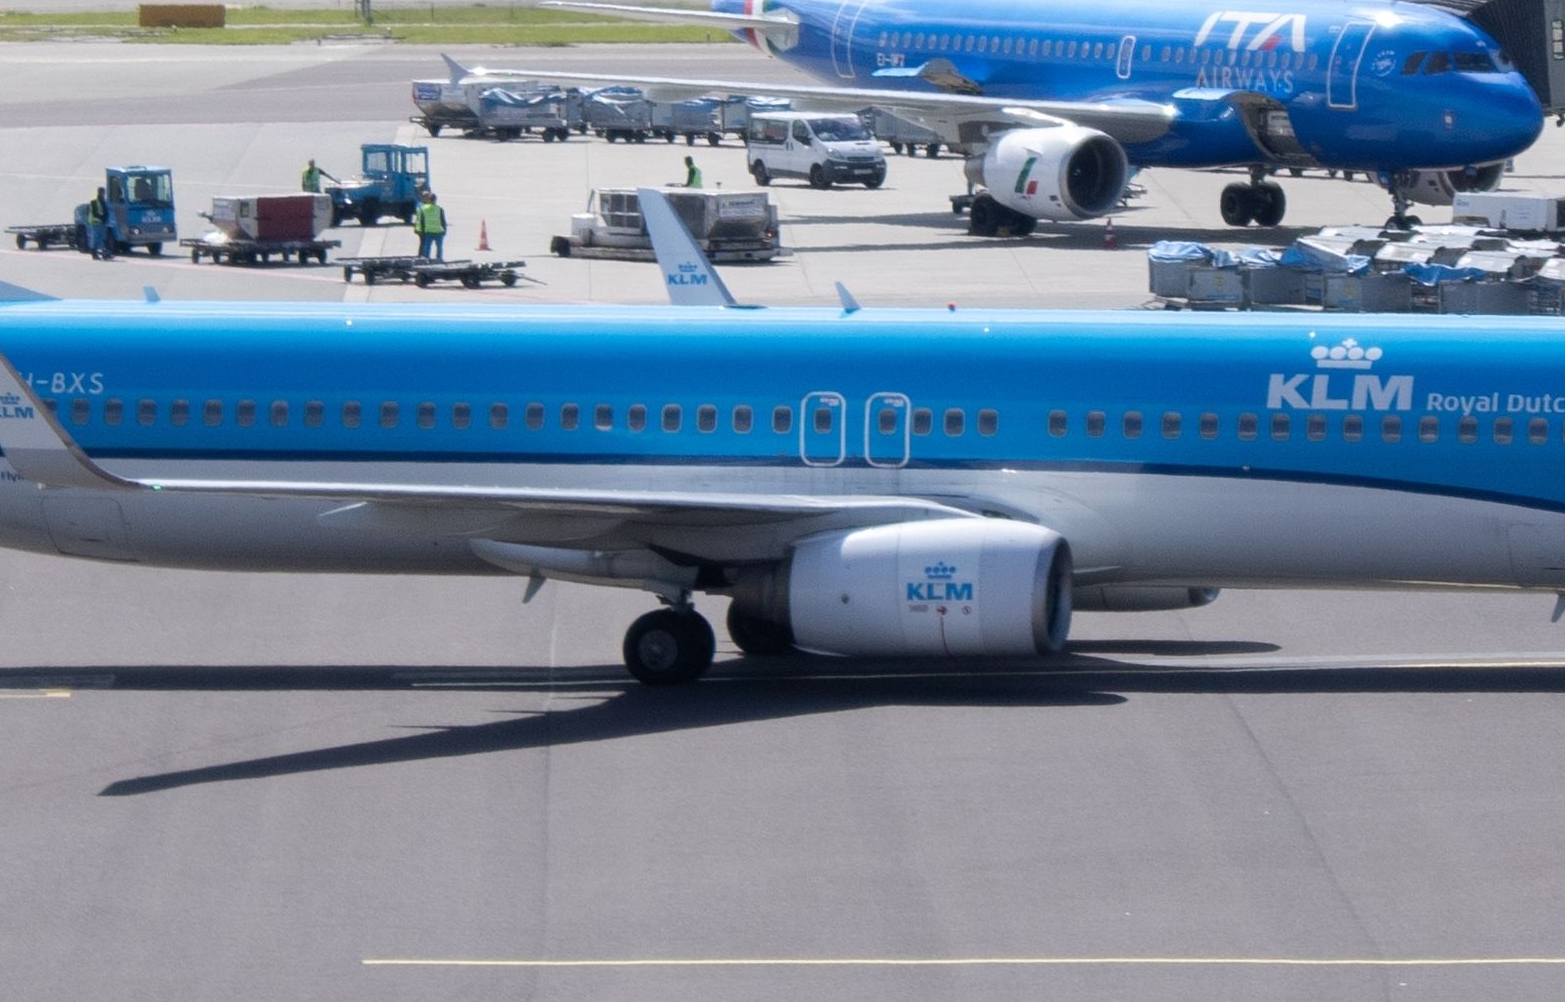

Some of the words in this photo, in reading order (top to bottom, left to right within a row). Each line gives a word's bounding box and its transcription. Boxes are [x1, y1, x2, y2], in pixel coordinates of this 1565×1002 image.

[1194, 11, 1306, 53] ITA
[1197, 66, 1293, 94] AIRWAYS
[668, 274, 707, 285] KLM
[20, 372, 104, 394] H-BXS
[1266, 374, 1415, 410] KLM
[1427, 392, 1500, 415] Royal
[907, 582, 973, 600] KLM
